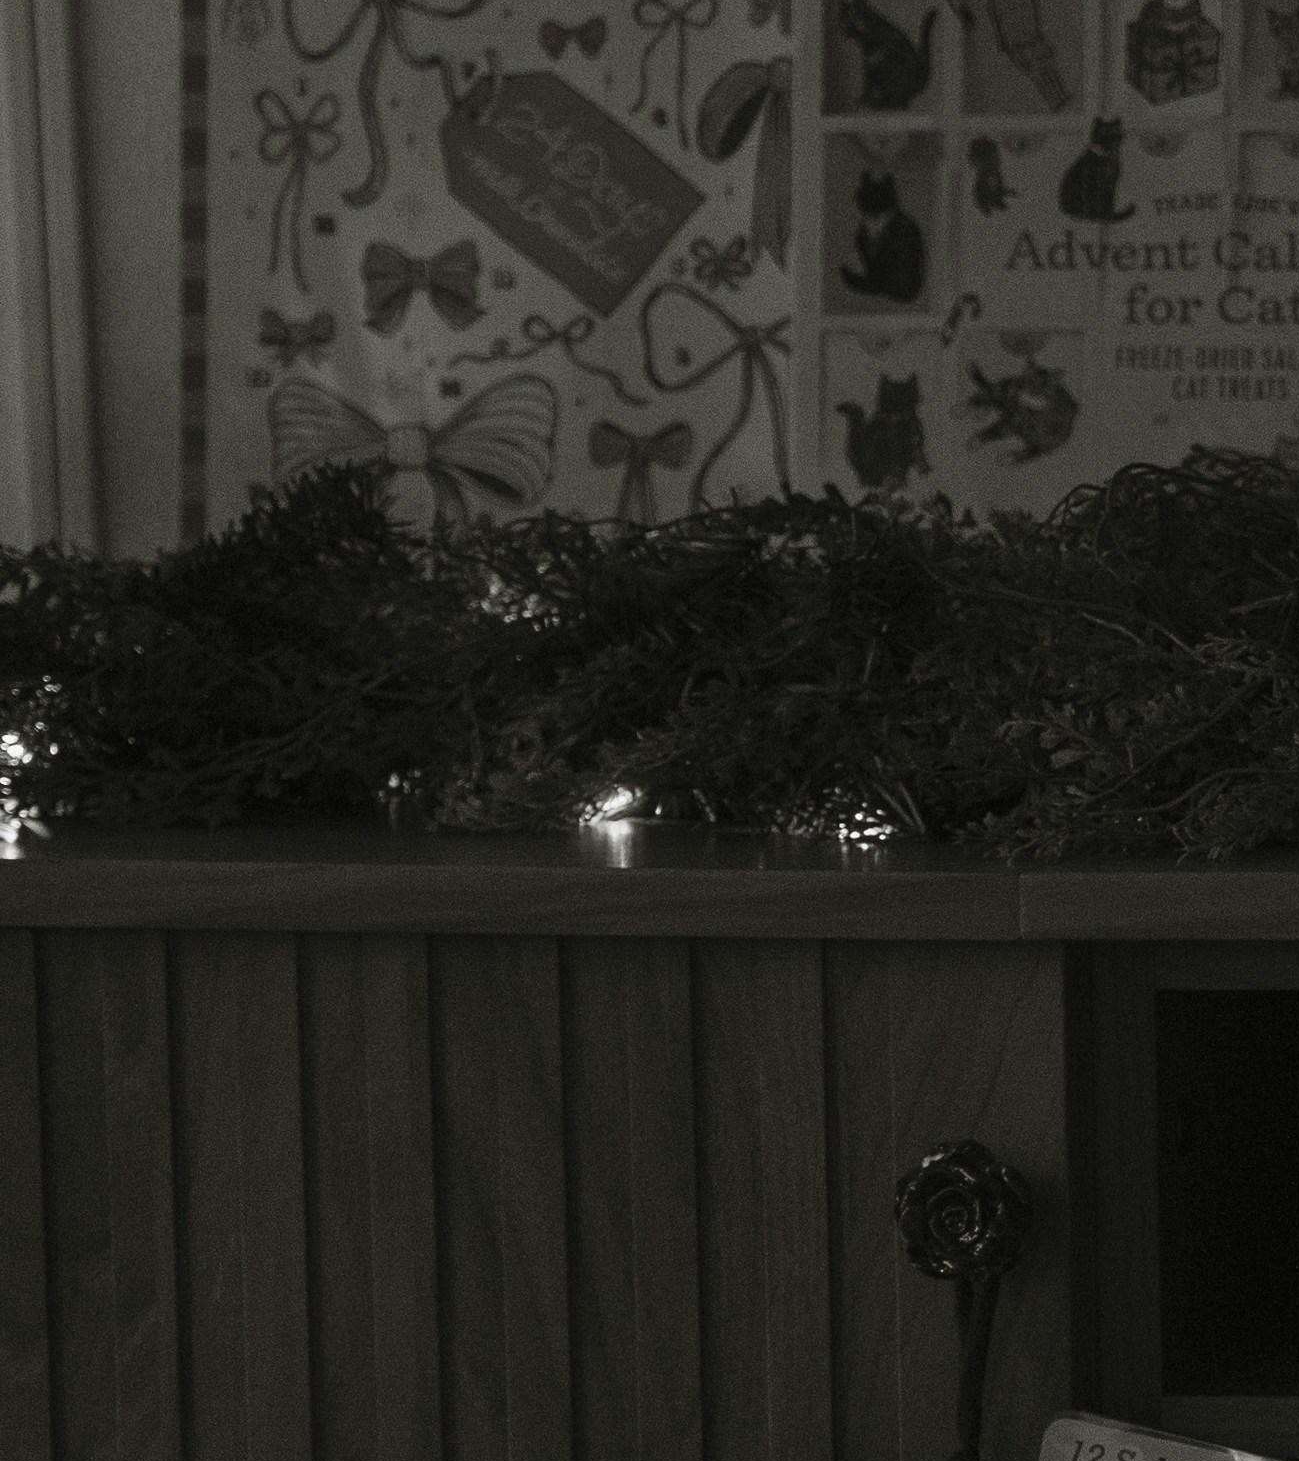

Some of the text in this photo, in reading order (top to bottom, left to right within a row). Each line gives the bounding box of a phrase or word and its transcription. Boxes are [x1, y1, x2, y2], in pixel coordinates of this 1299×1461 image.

[1004, 229, 1201, 272] Advent
[1123, 281, 1204, 326] for
[1171, 376, 1292, 402] CAT TREATS
